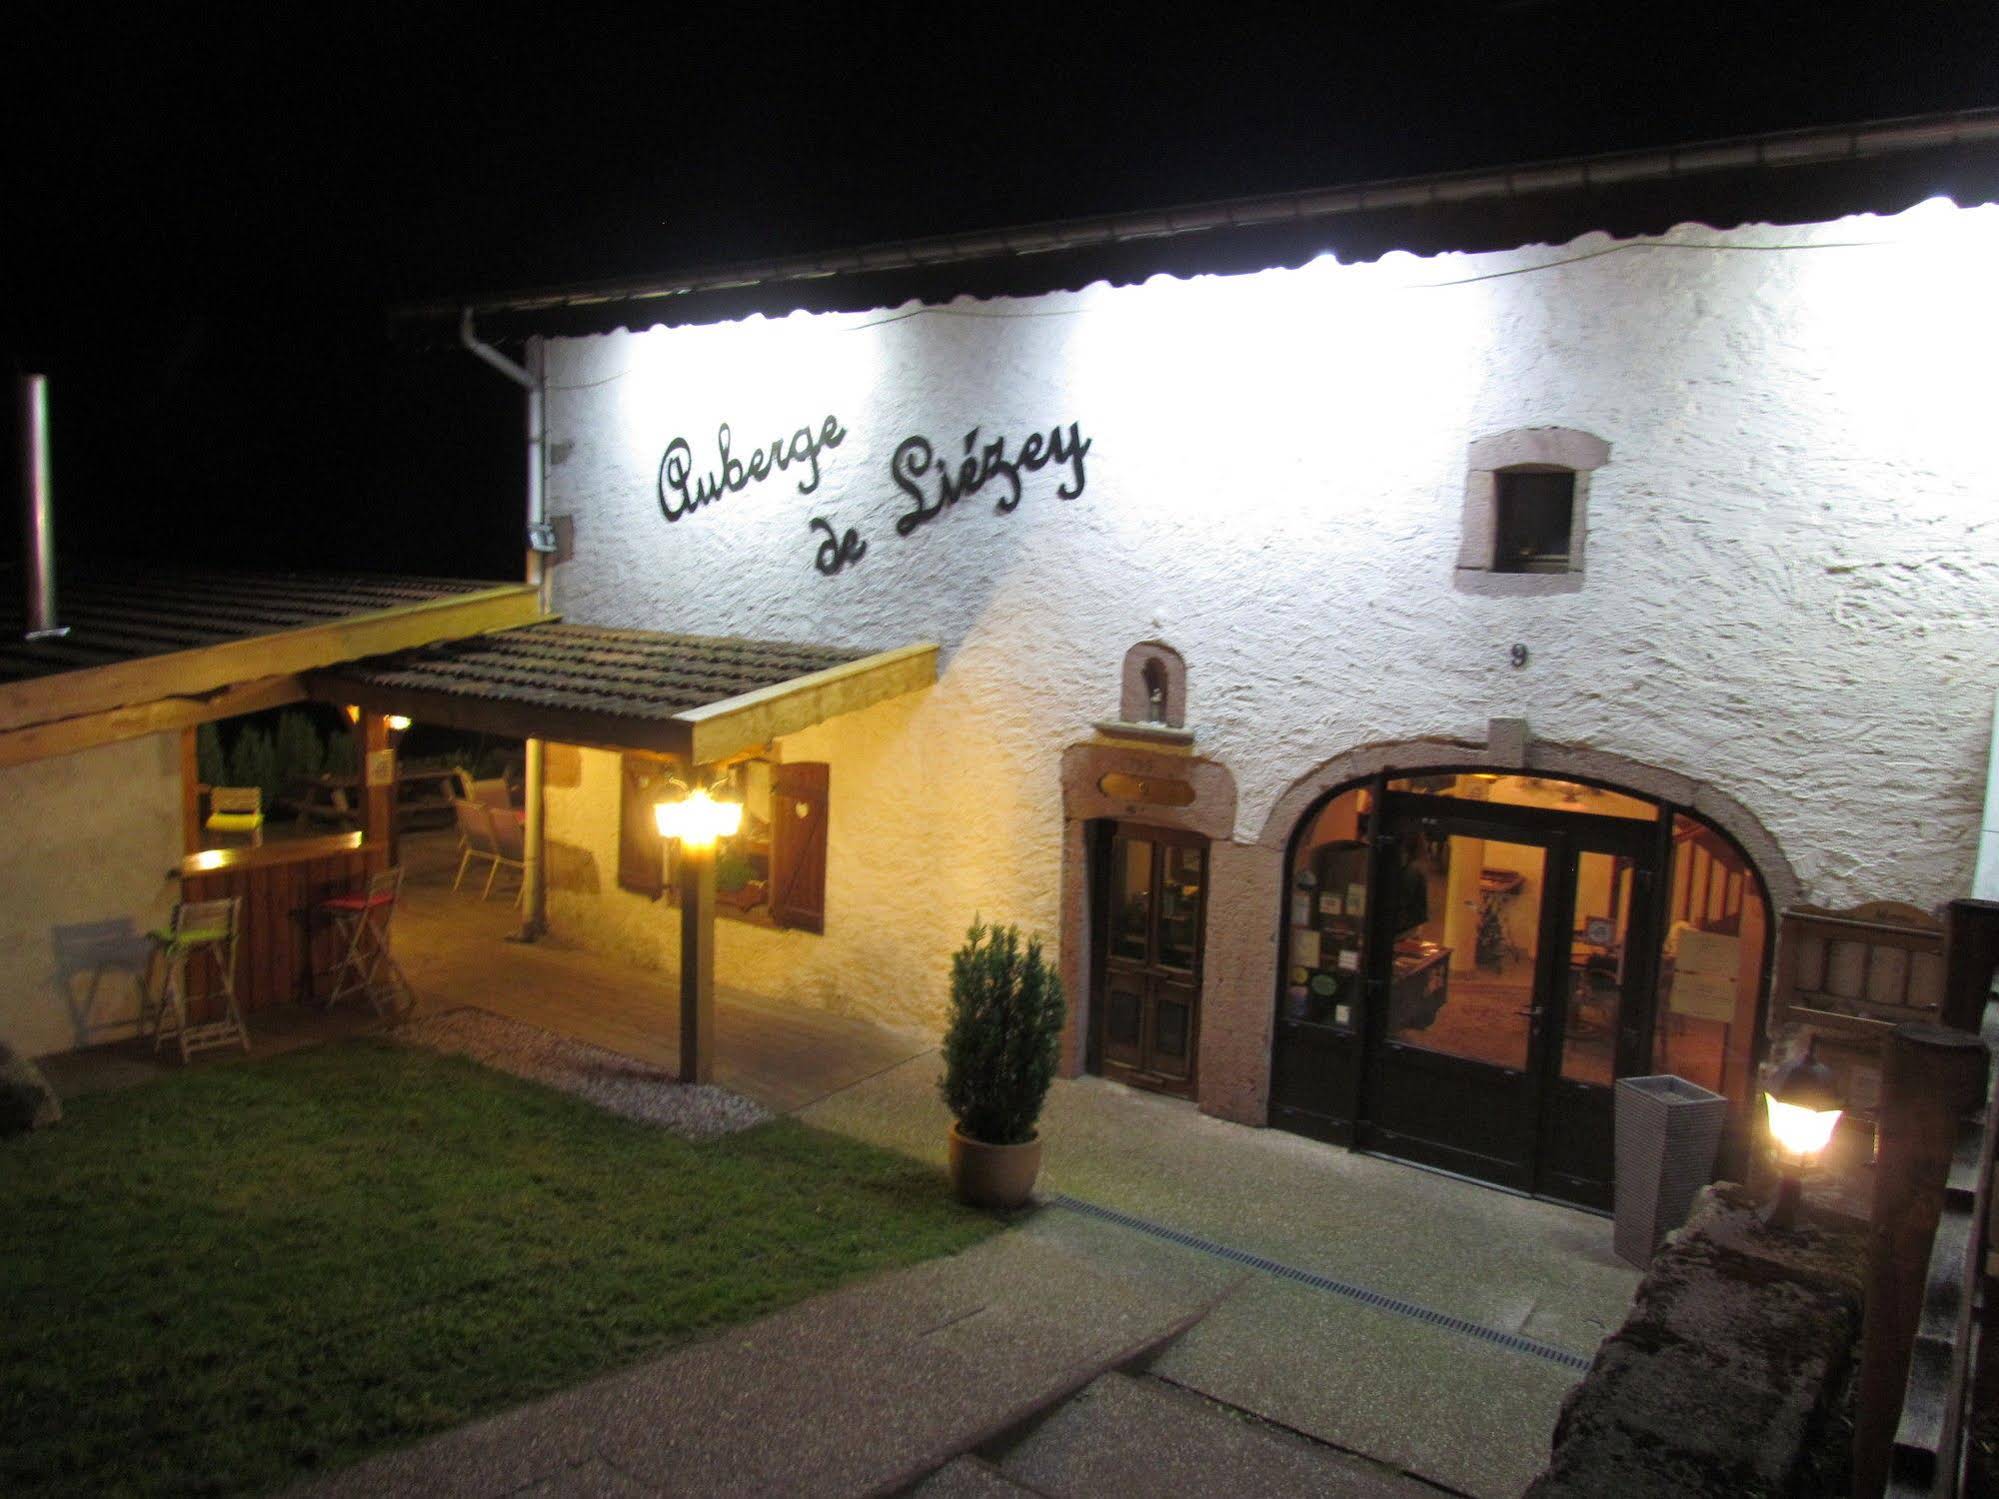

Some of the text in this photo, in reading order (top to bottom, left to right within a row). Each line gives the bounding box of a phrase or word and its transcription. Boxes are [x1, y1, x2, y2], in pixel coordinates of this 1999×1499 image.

[658, 414, 1092, 577] Auberge de Liézey
[1512, 643, 1527, 667] 9
